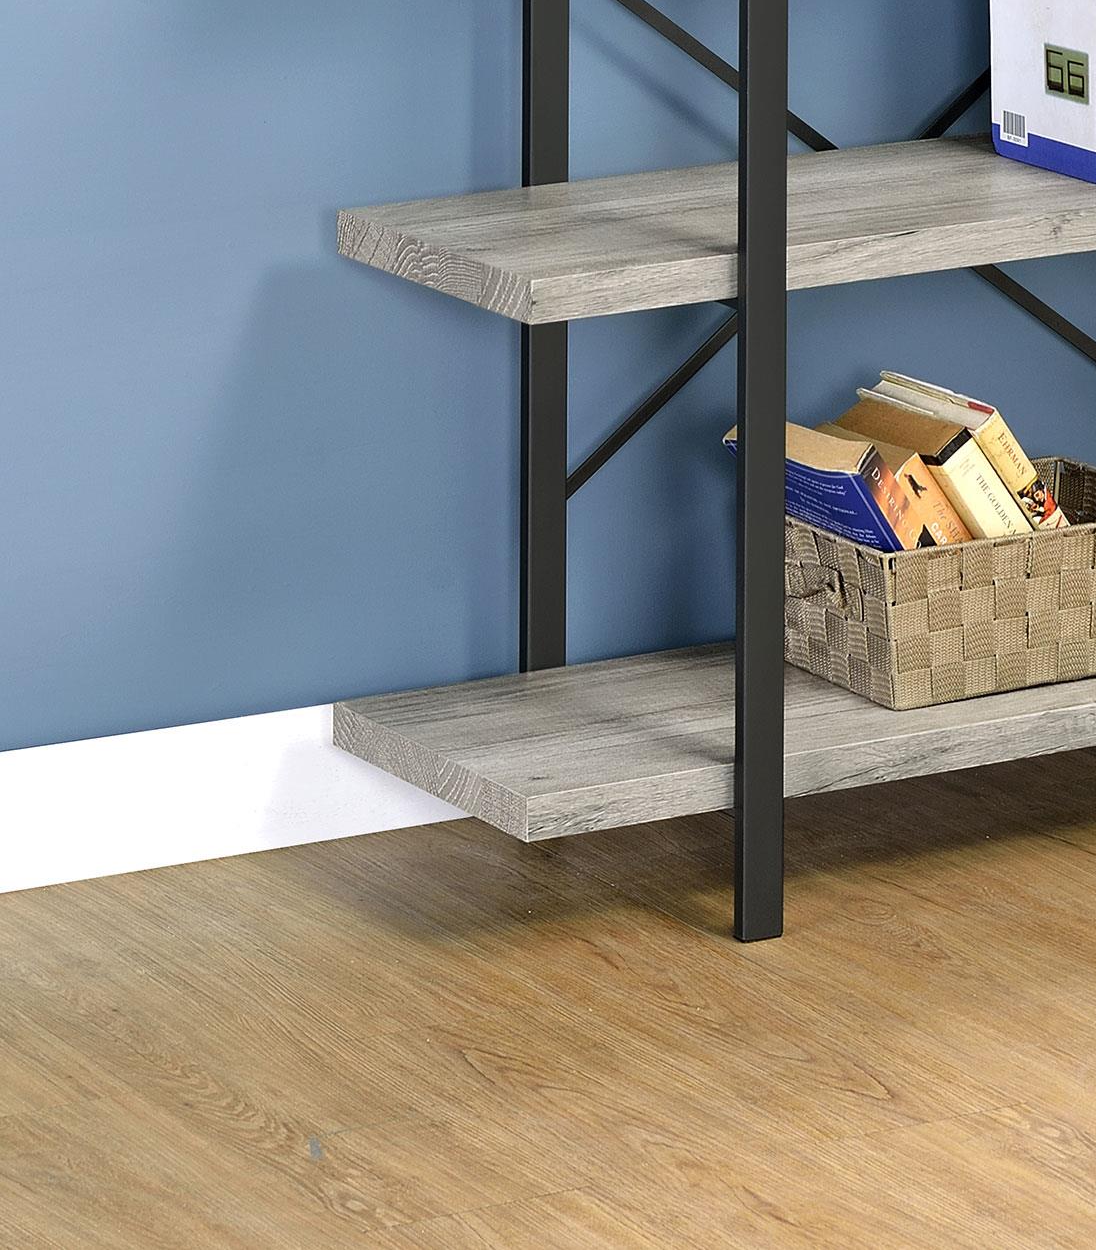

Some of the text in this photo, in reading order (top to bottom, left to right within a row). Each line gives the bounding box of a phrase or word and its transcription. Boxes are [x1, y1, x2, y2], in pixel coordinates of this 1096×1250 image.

[996, 432, 1028, 475] EHRMAN
[933, 500, 947, 520] The
[975, 472, 990, 494] THE
[987, 492, 1014, 529] GOLDEN
